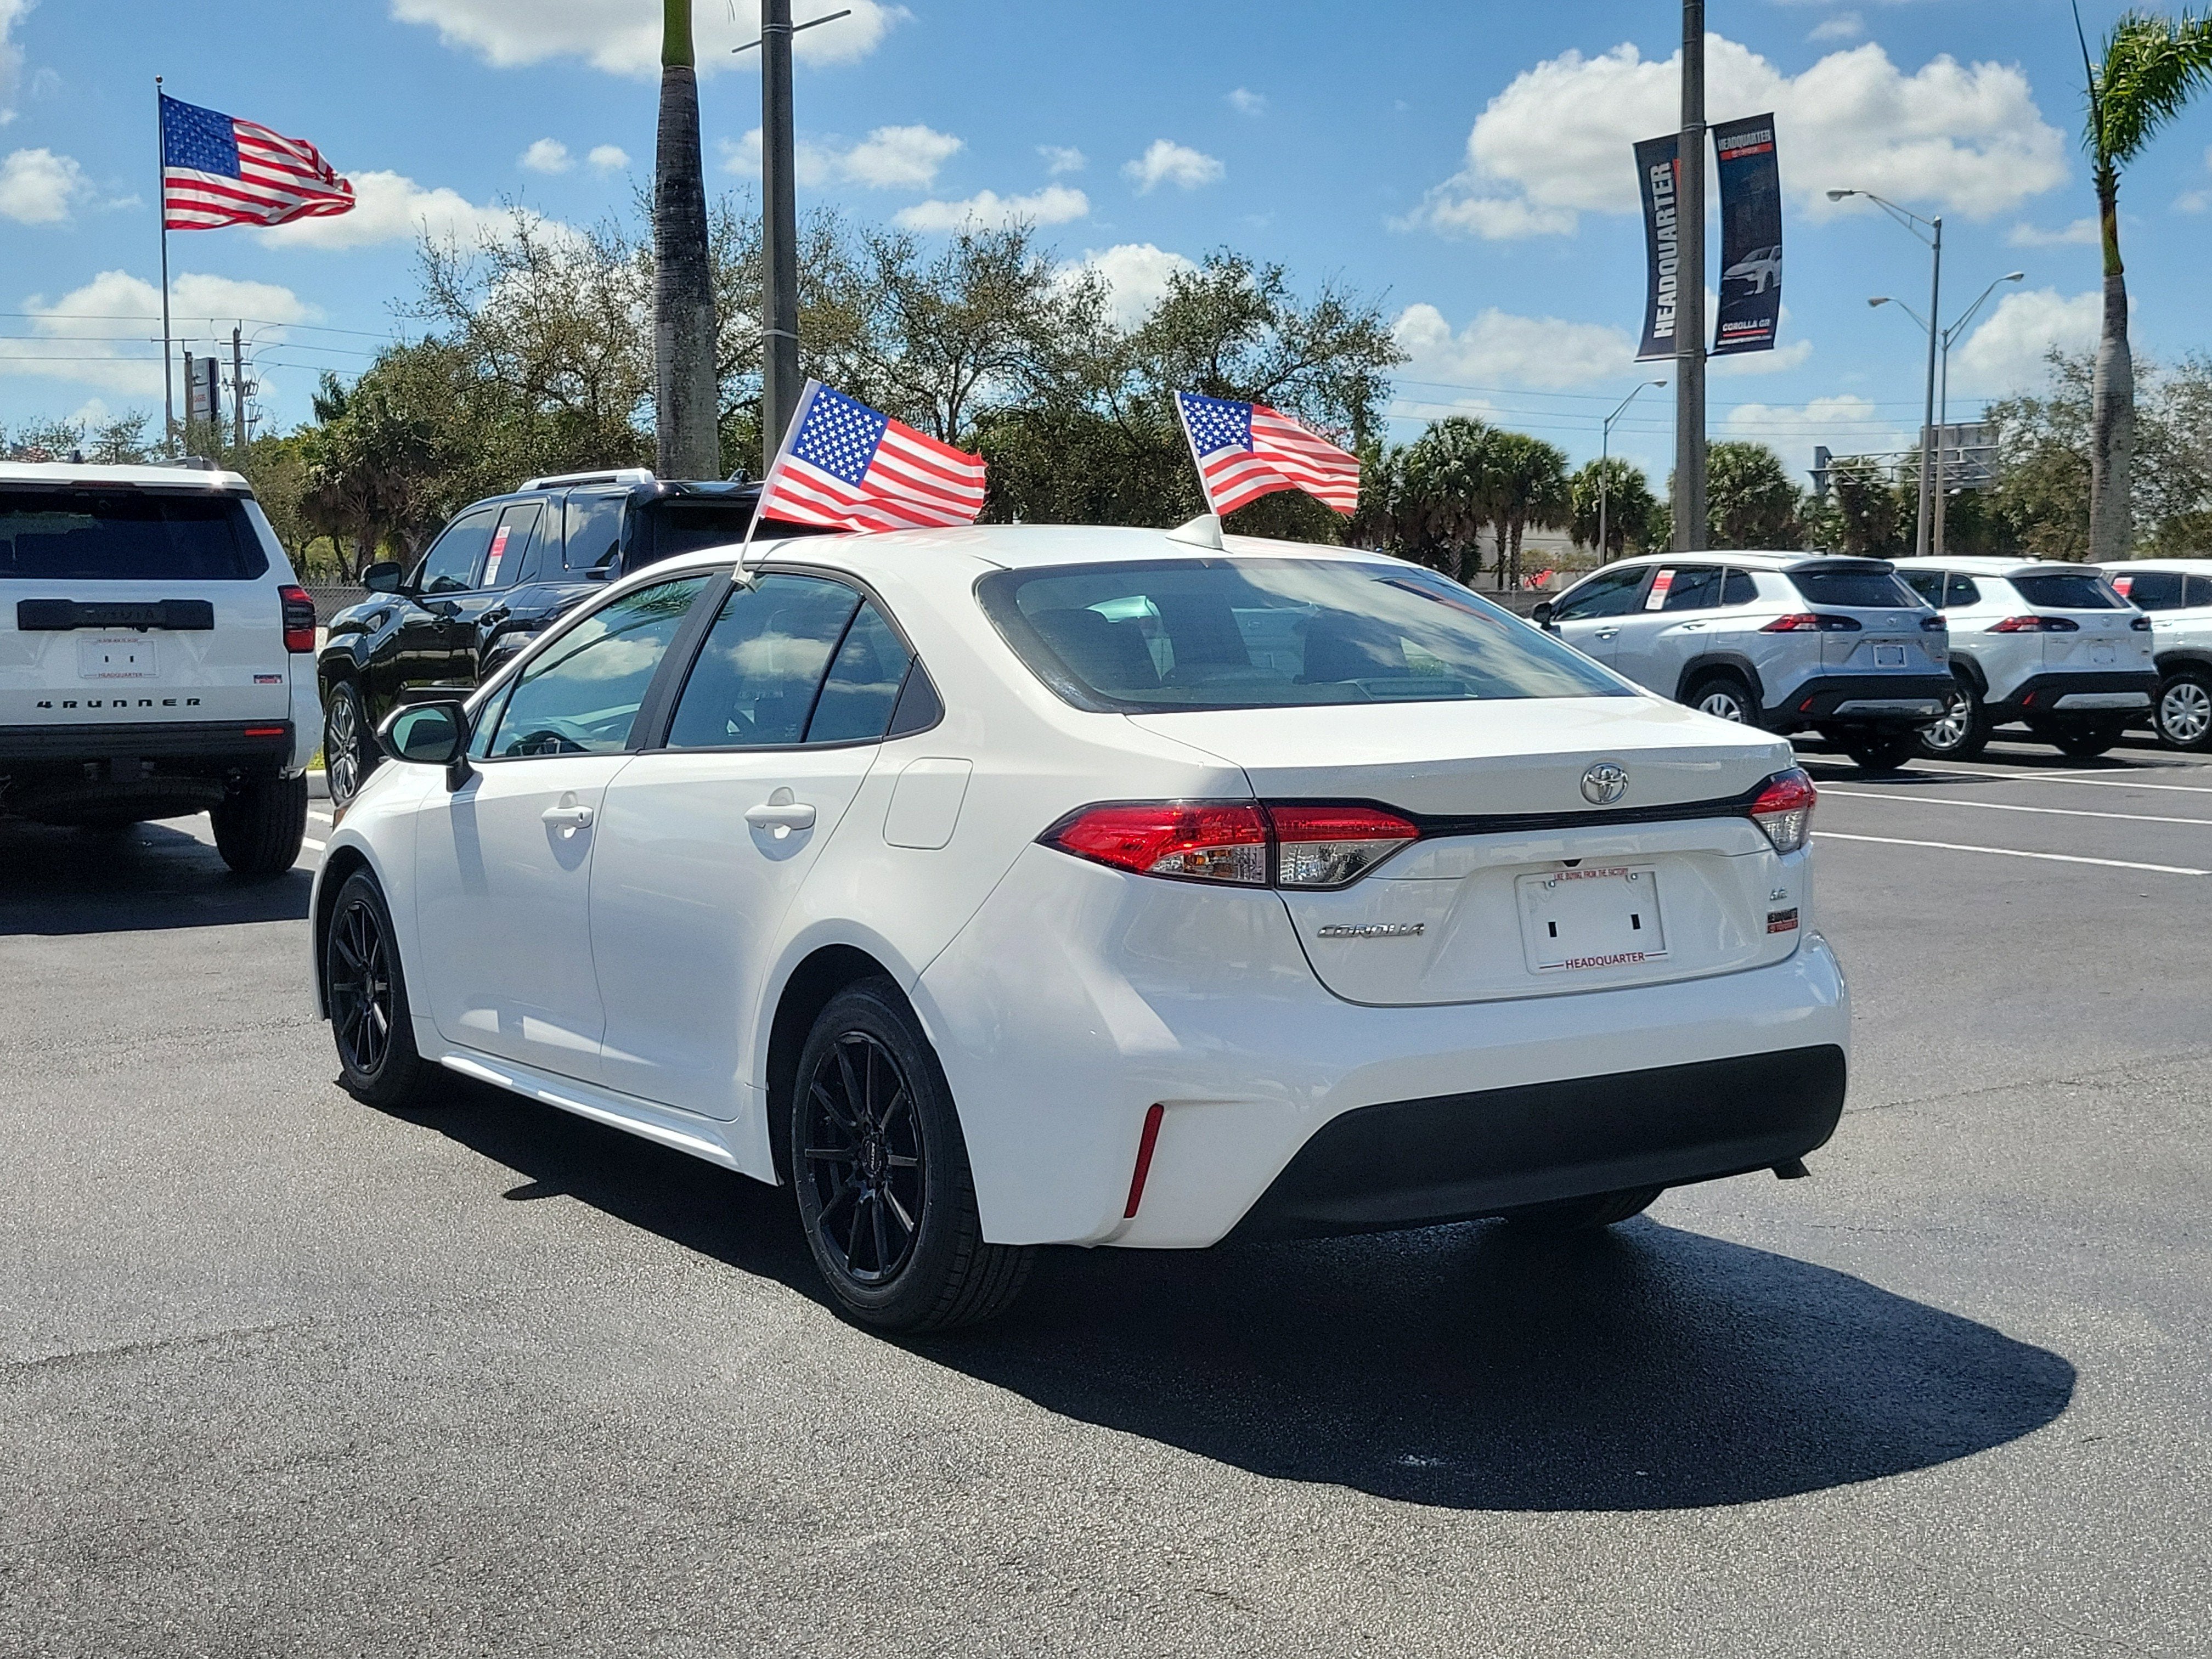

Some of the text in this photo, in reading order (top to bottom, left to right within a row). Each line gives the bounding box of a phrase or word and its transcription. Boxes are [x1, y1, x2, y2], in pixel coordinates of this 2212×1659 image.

[1650, 162, 1679, 338] HEADQUARTER
[1723, 320, 1758, 332] COROLLA
[37, 698, 201, 708] 4RUNNER
[1317, 923, 1424, 938] COROLLA
[1565, 952, 1645, 969] HEADQUARTER
